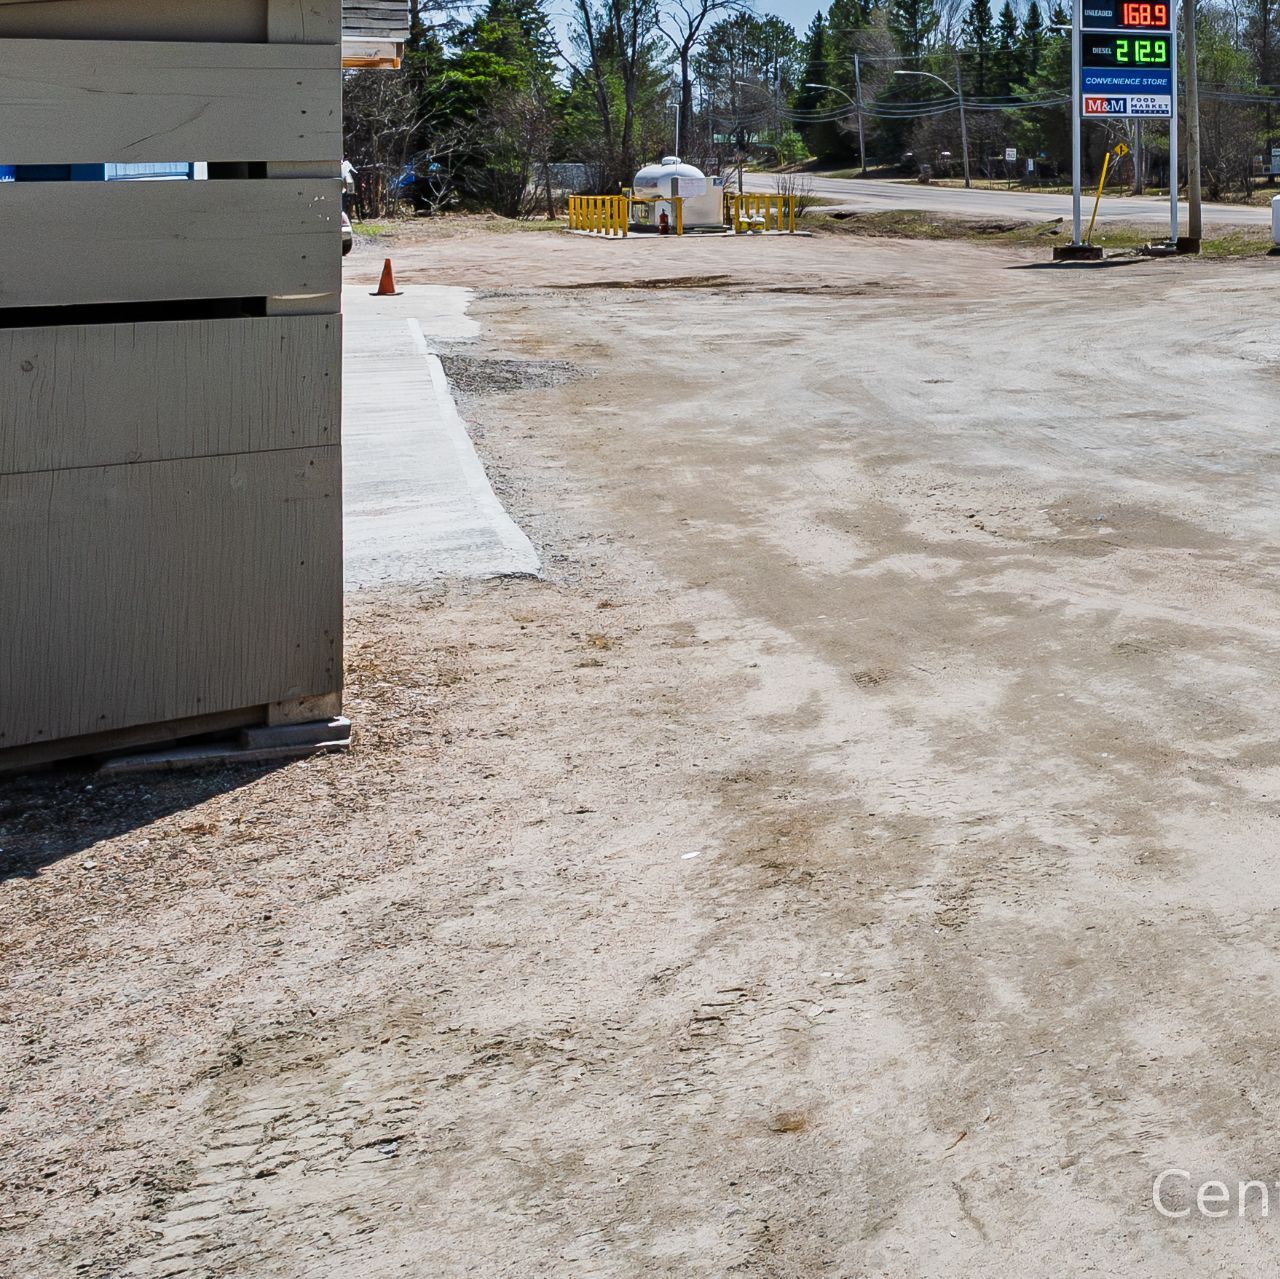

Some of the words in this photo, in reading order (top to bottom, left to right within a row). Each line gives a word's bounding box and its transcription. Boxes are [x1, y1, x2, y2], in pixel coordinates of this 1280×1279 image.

[1084, 9, 1113, 17] UNLEADED
[1123, 3, 1167, 26] 168.9
[1085, 77, 1141, 85] CONVENIENCE
[1142, 78, 1168, 86] STORE
[1087, 99, 1124, 112] M&M
